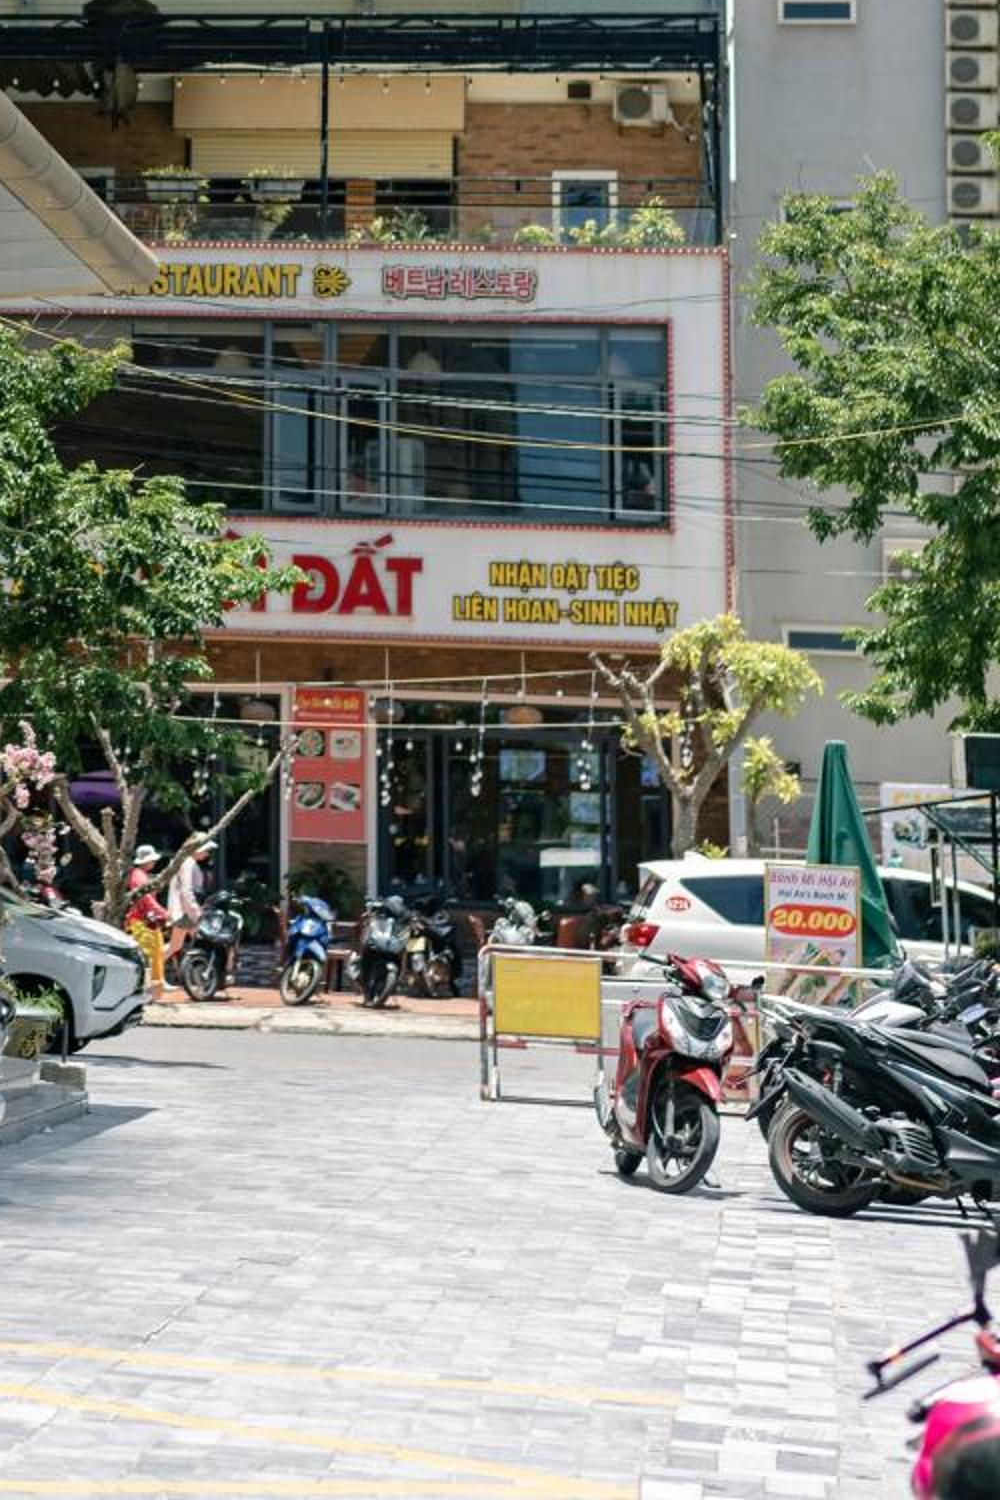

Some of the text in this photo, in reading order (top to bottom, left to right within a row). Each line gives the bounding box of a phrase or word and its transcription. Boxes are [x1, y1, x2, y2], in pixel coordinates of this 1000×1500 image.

[291, 533, 424, 616] ĐẤT
[488, 558, 547, 593] NHẬN
[593, 560, 641, 597] TIỆC
[452, 590, 499, 623] LIÊN
[623, 597, 680, 633] NHẬT
[773, 908, 853, 932] 20.000
